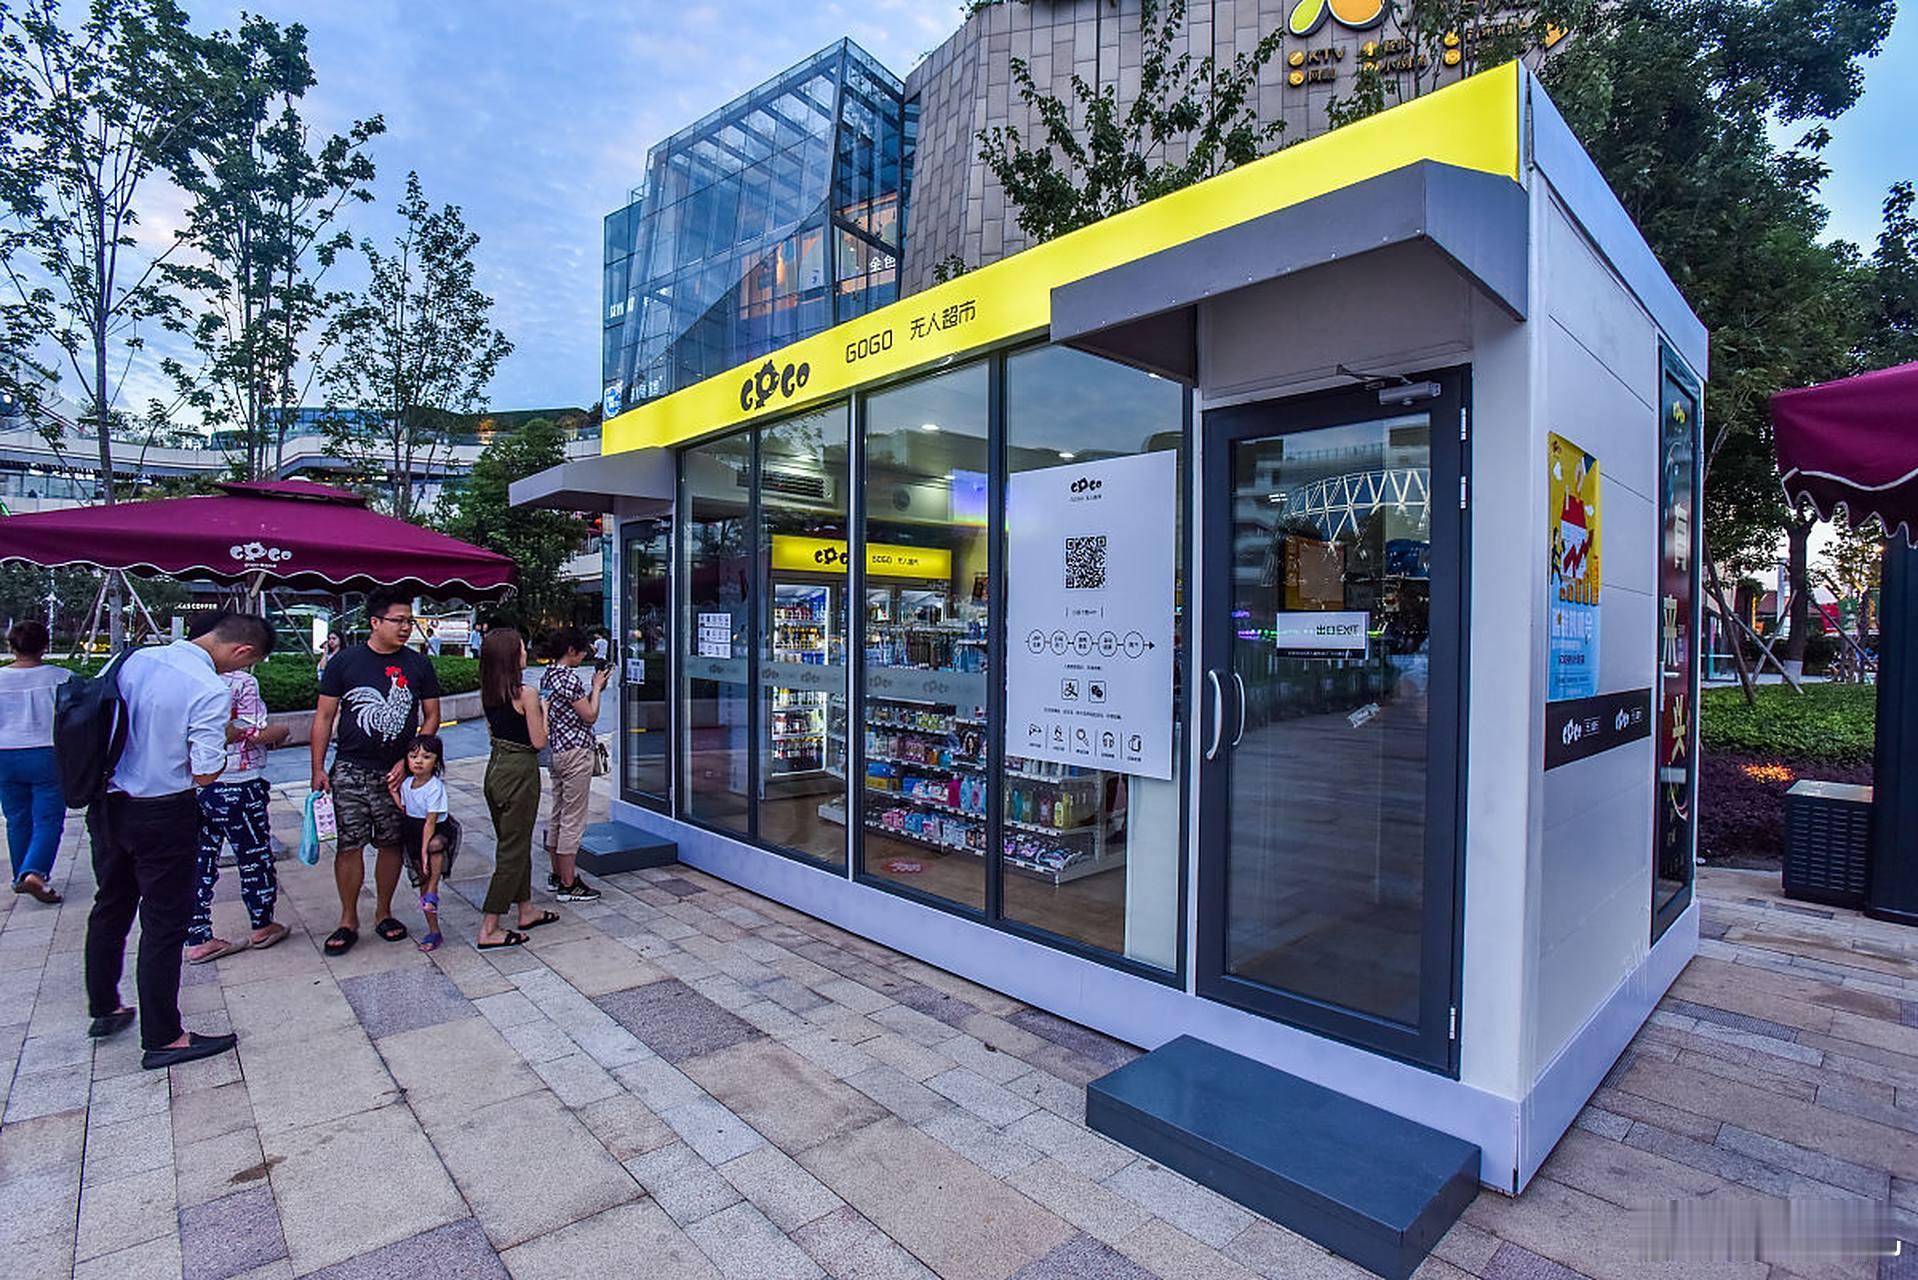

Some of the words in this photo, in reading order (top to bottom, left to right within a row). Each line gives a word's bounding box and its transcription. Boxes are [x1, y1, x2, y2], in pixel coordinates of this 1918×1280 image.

[1308, 47, 1344, 64] KTV
[845, 330, 893, 363] GOGO
[909, 300, 976, 340] 无人超市
